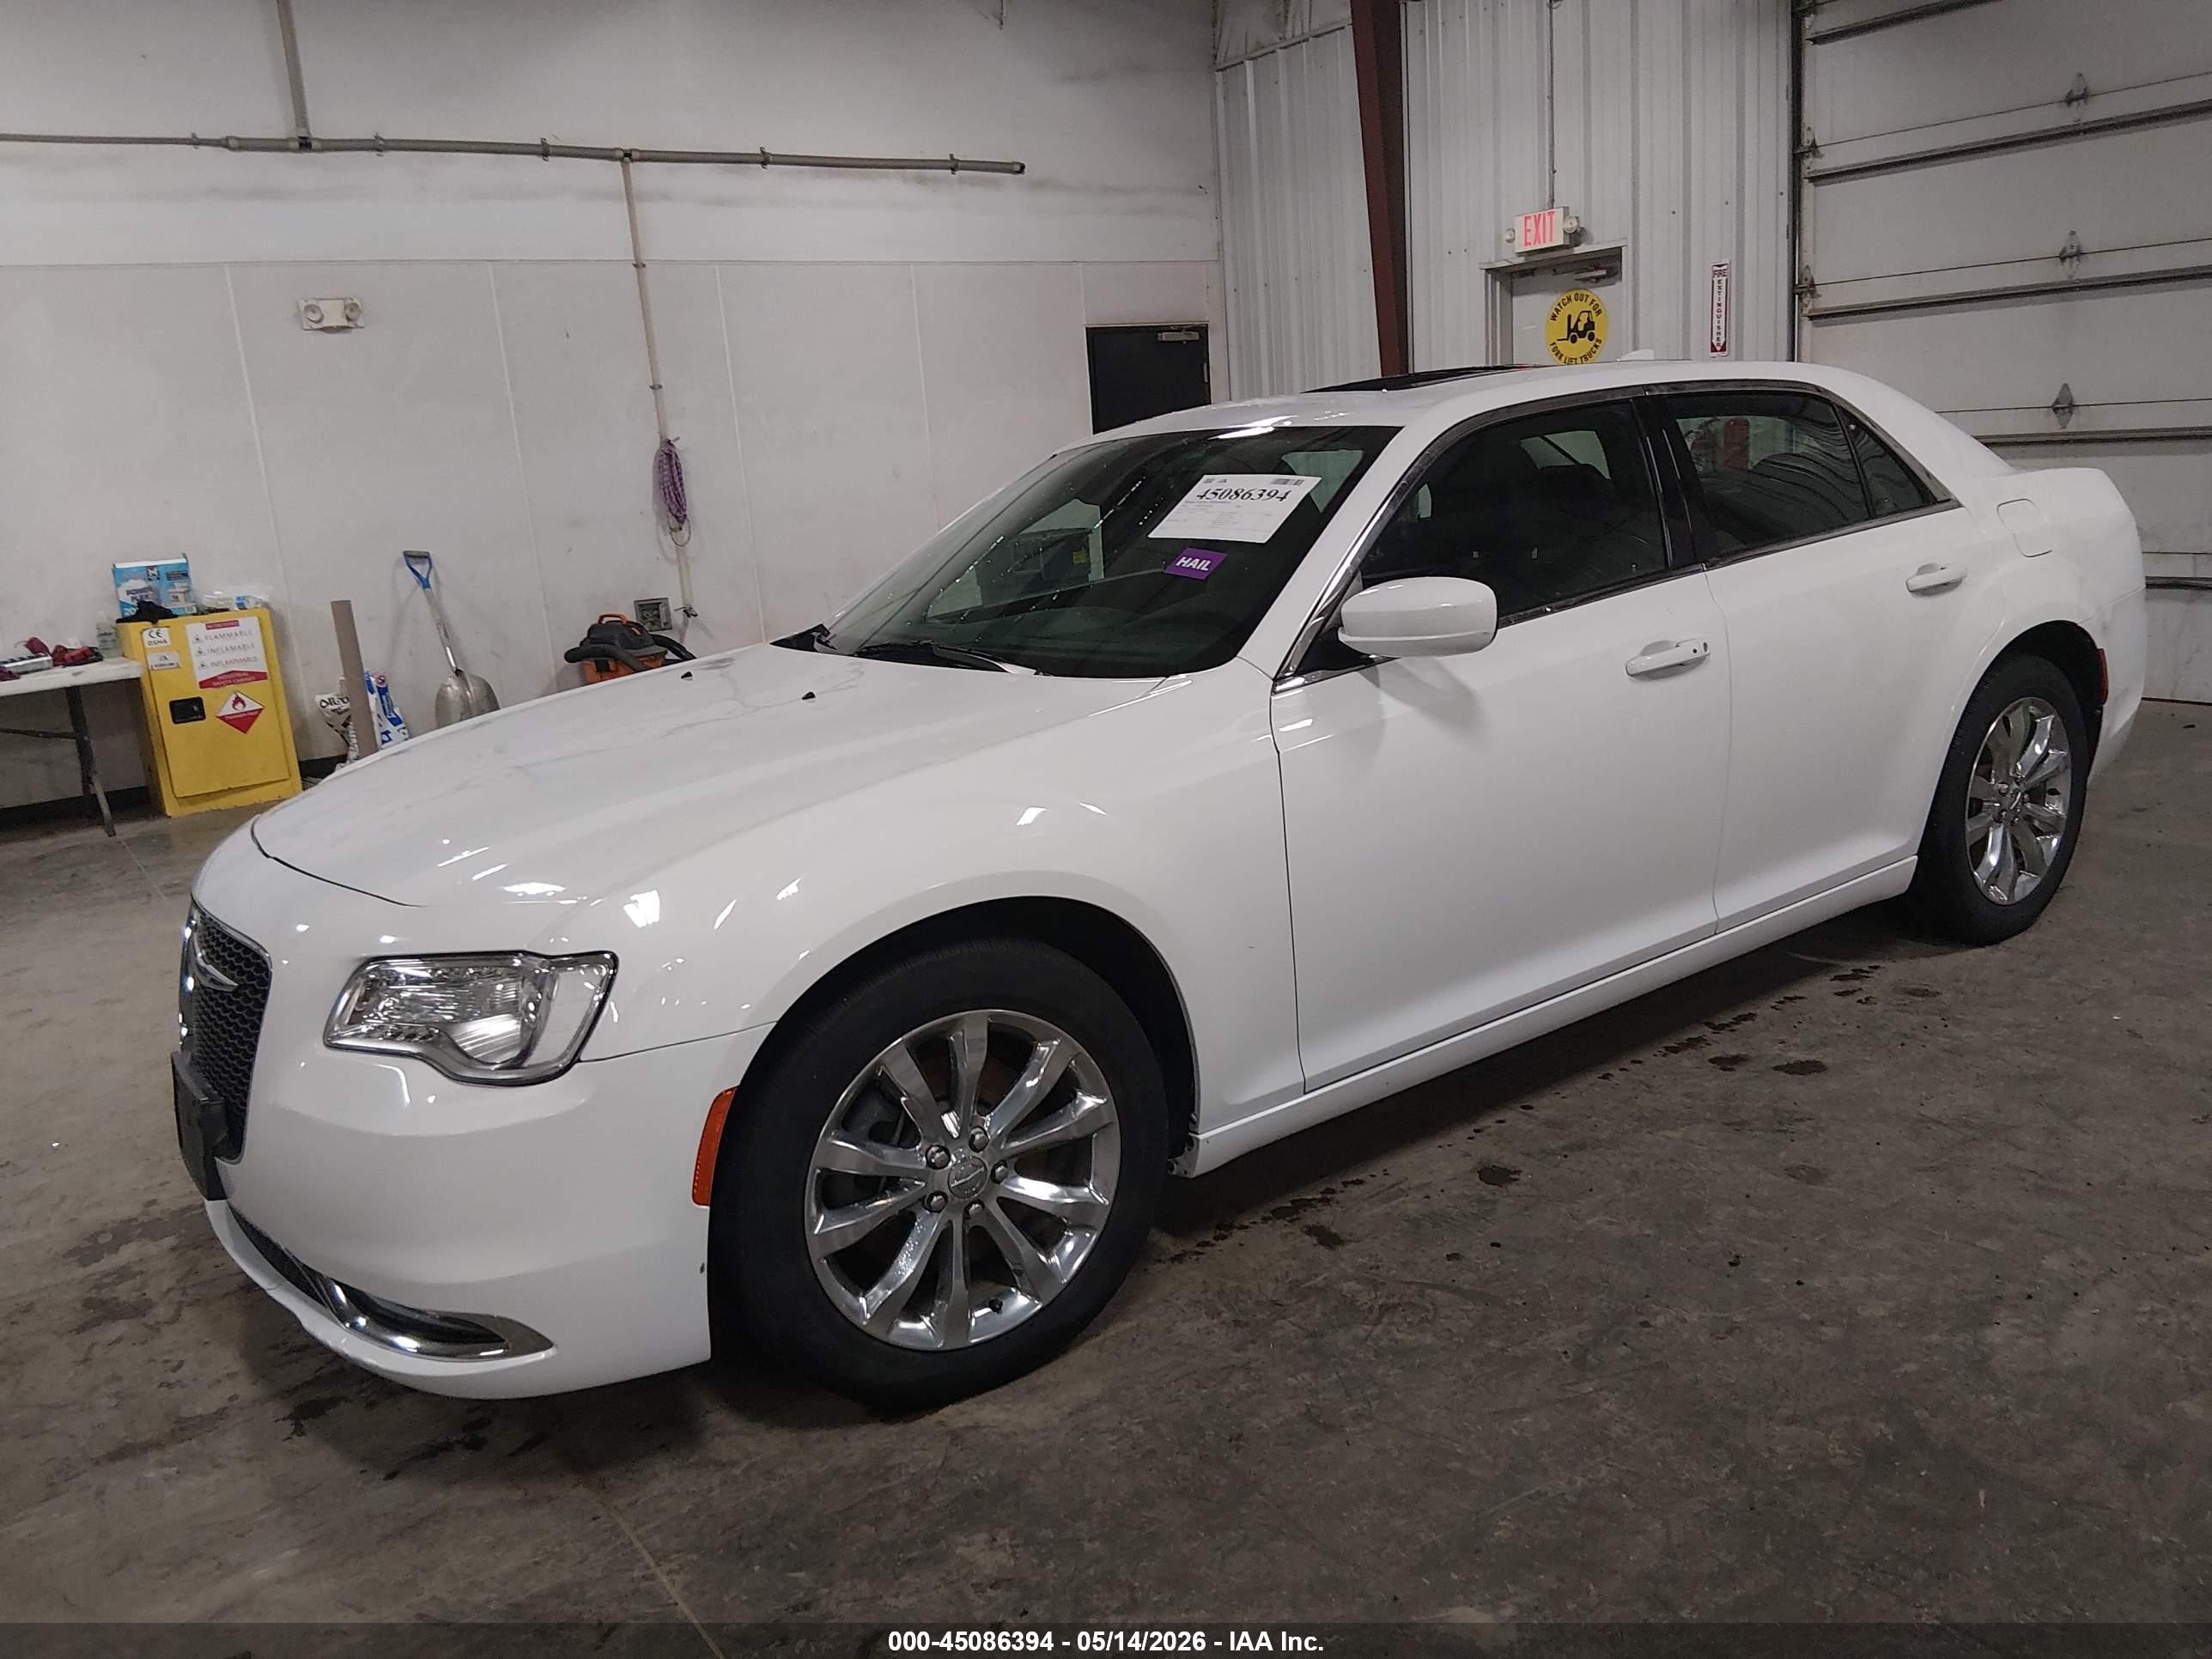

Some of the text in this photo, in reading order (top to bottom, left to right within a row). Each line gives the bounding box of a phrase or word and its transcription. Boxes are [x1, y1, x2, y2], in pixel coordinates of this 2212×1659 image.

[1524, 210, 1555, 246] EXIT
[1550, 293, 1602, 321] WATCH OUT FOR
[1549, 337, 1602, 364] FORK LIFT TRUCKS
[1196, 488, 1292, 501] 45086394
[1176, 556, 1212, 571] HAIL
